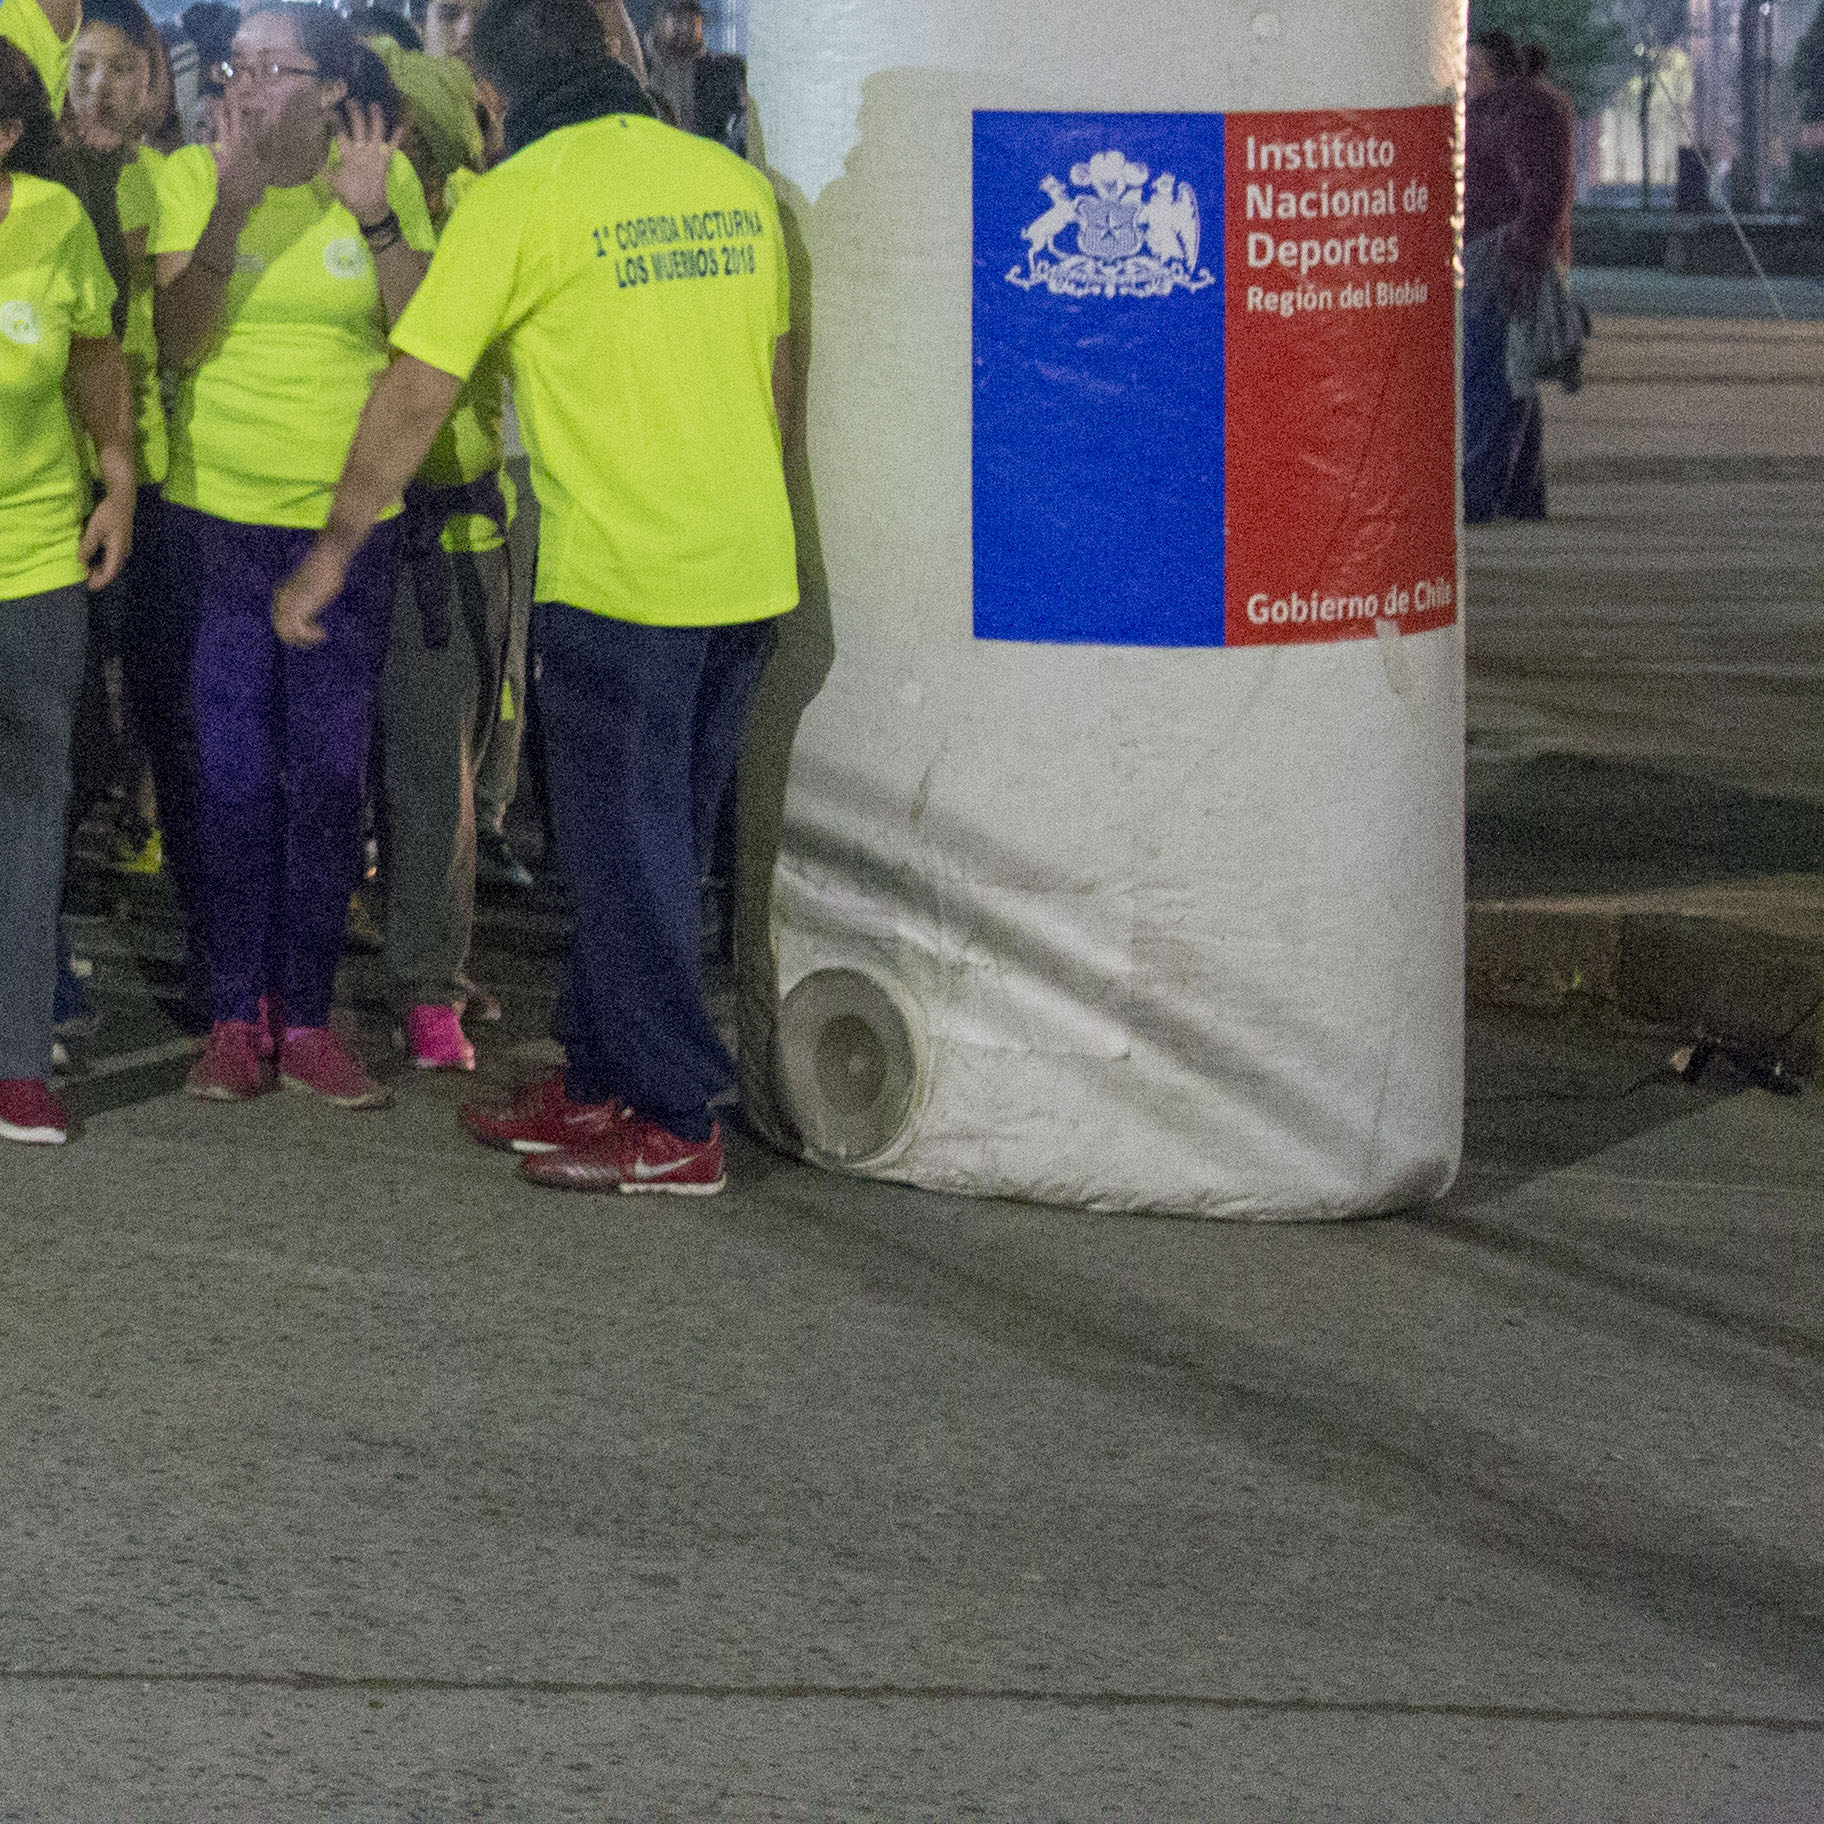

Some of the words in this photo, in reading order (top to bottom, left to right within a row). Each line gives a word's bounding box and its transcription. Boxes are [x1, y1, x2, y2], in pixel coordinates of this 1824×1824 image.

[1246, 135, 1394, 171] Instituto
[1246, 180, 1395, 220] Nacional
[1402, 179, 1429, 211] de
[615, 216, 680, 250] CORRIDA
[681, 210, 763, 241] NOCTURNA
[615, 255, 649, 288] LOS
[721, 244, 755, 276] 2018
[1246, 231, 1399, 276] Deportes
[1246, 284, 1333, 316] Región
[1338, 282, 1372, 309] del
[1246, 591, 1378, 625] Gobierno
[1384, 585, 1410, 617] de
[1414, 579, 1452, 609] Chile
